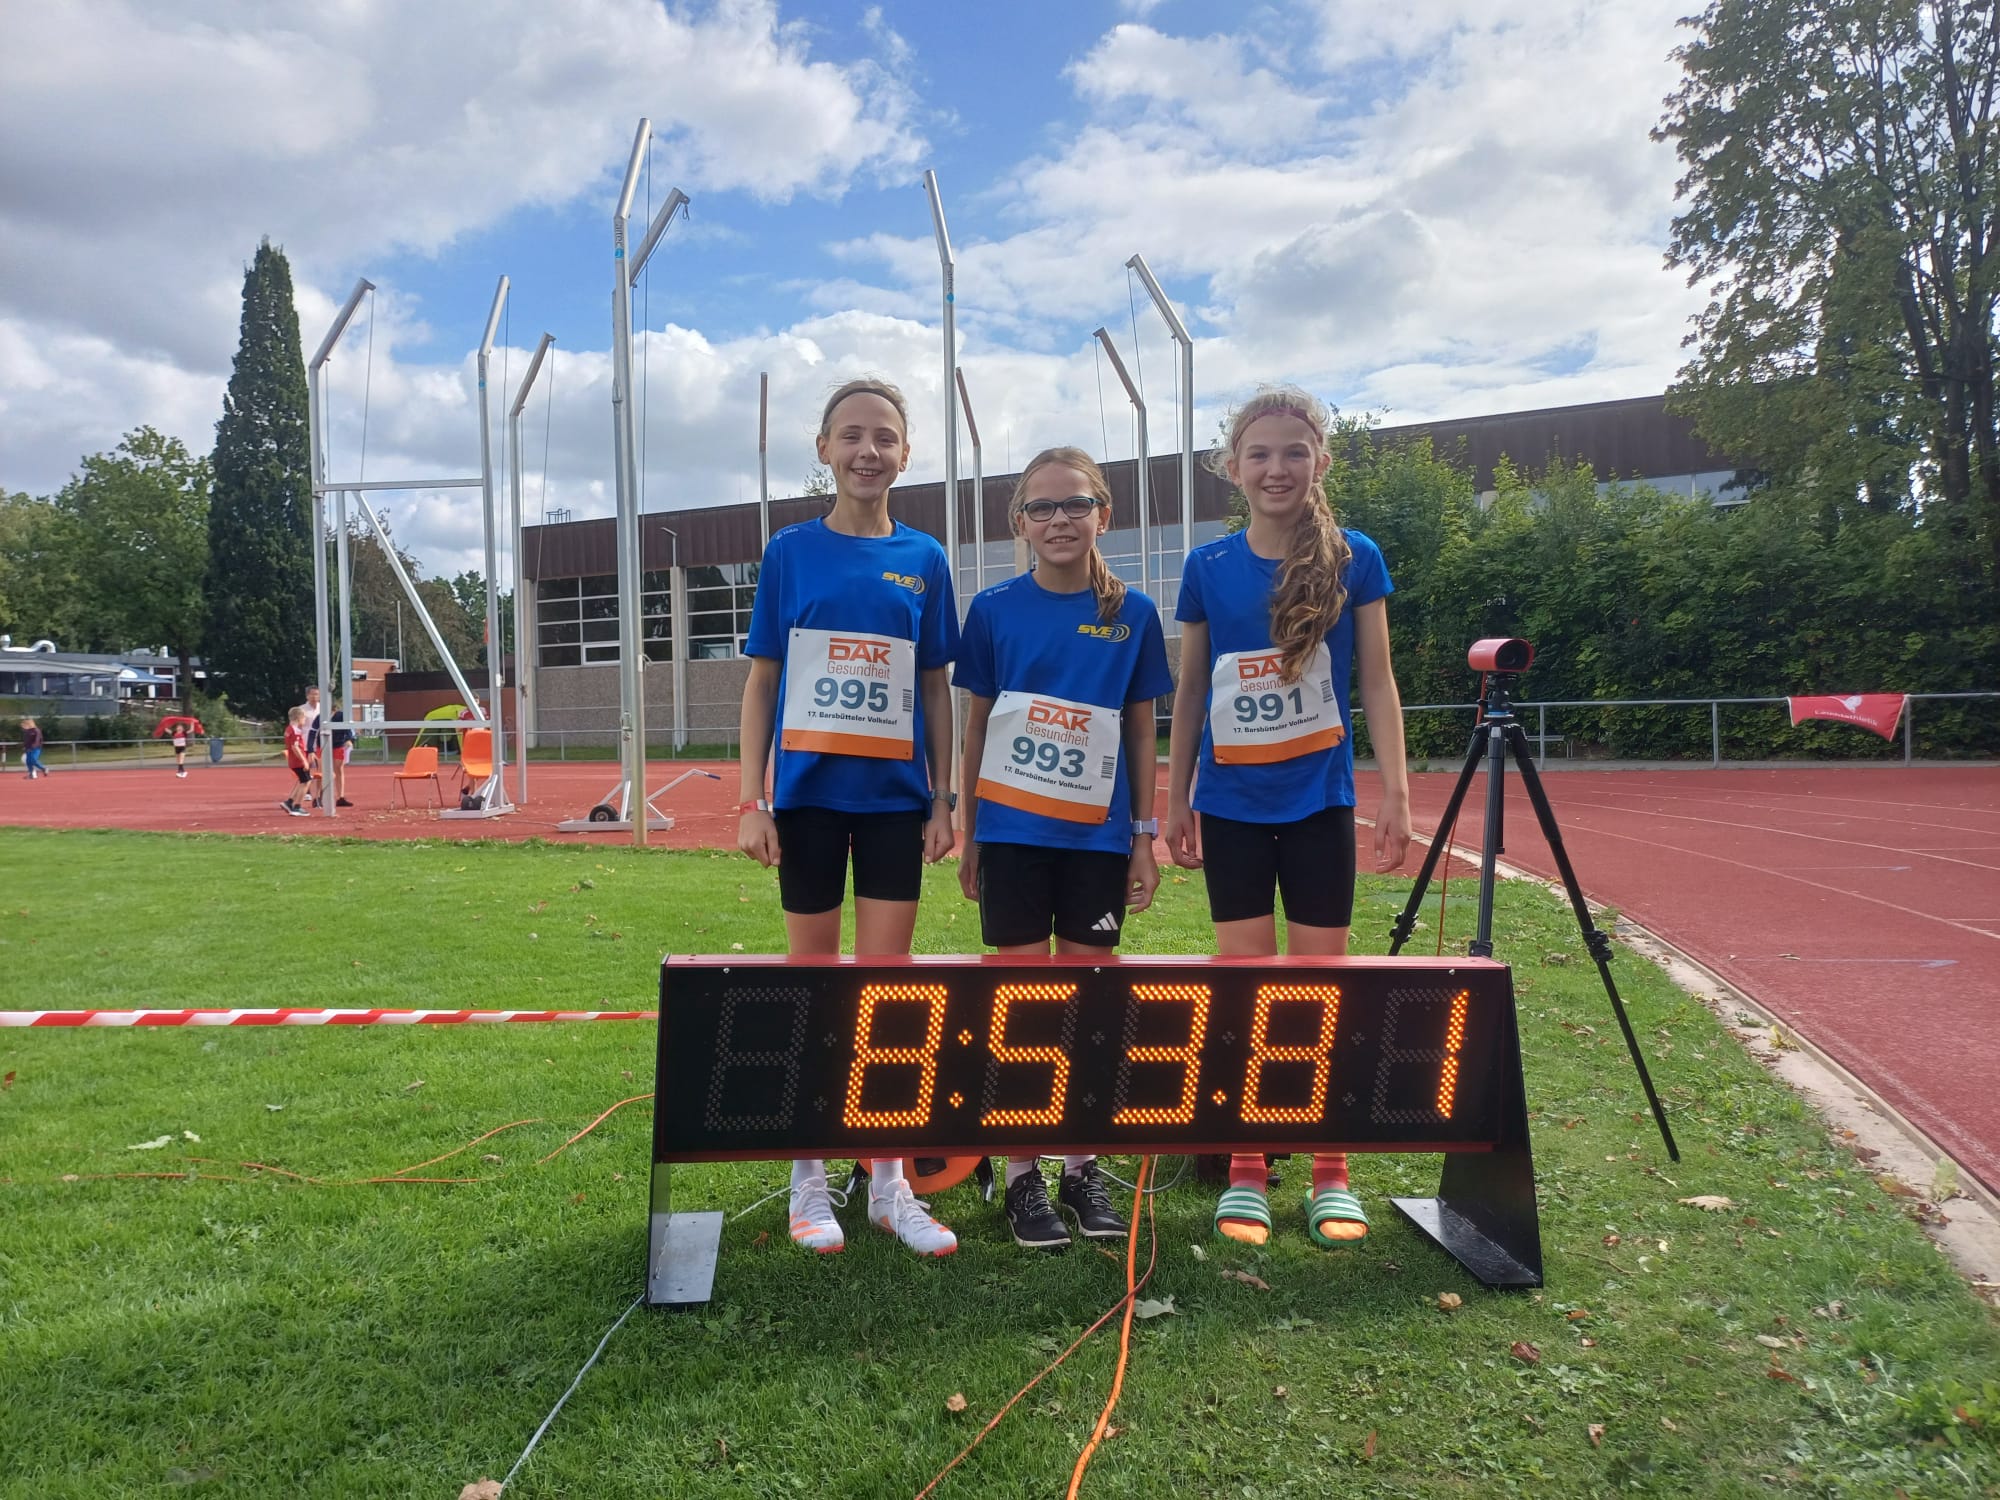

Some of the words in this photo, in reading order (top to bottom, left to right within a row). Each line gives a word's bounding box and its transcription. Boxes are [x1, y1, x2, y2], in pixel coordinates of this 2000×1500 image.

[881, 571, 916, 587] SVE
[1077, 624, 1114, 636] SVE
[828, 638, 891, 665] DAK
[827, 661, 890, 679] Gesundheit
[1238, 653, 1286, 679] DA
[813, 677, 889, 712] 995
[1233, 687, 1303, 722] 991
[819, 711, 866, 722] Barsbütteler
[868, 716, 898, 725] Volkslauf
[1027, 700, 1092, 733] DAK
[1244, 723, 1288, 733] Barsbütteler
[1289, 714, 1319, 727] Volkslauf
[1025, 721, 1089, 747] Gesundheit
[1011, 736, 1086, 778] 993
[1004, 765, 1013, 774] 17.
[1014, 769, 1057, 785] Barsbütteler
[1058, 780, 1092, 792] Volkslauf
